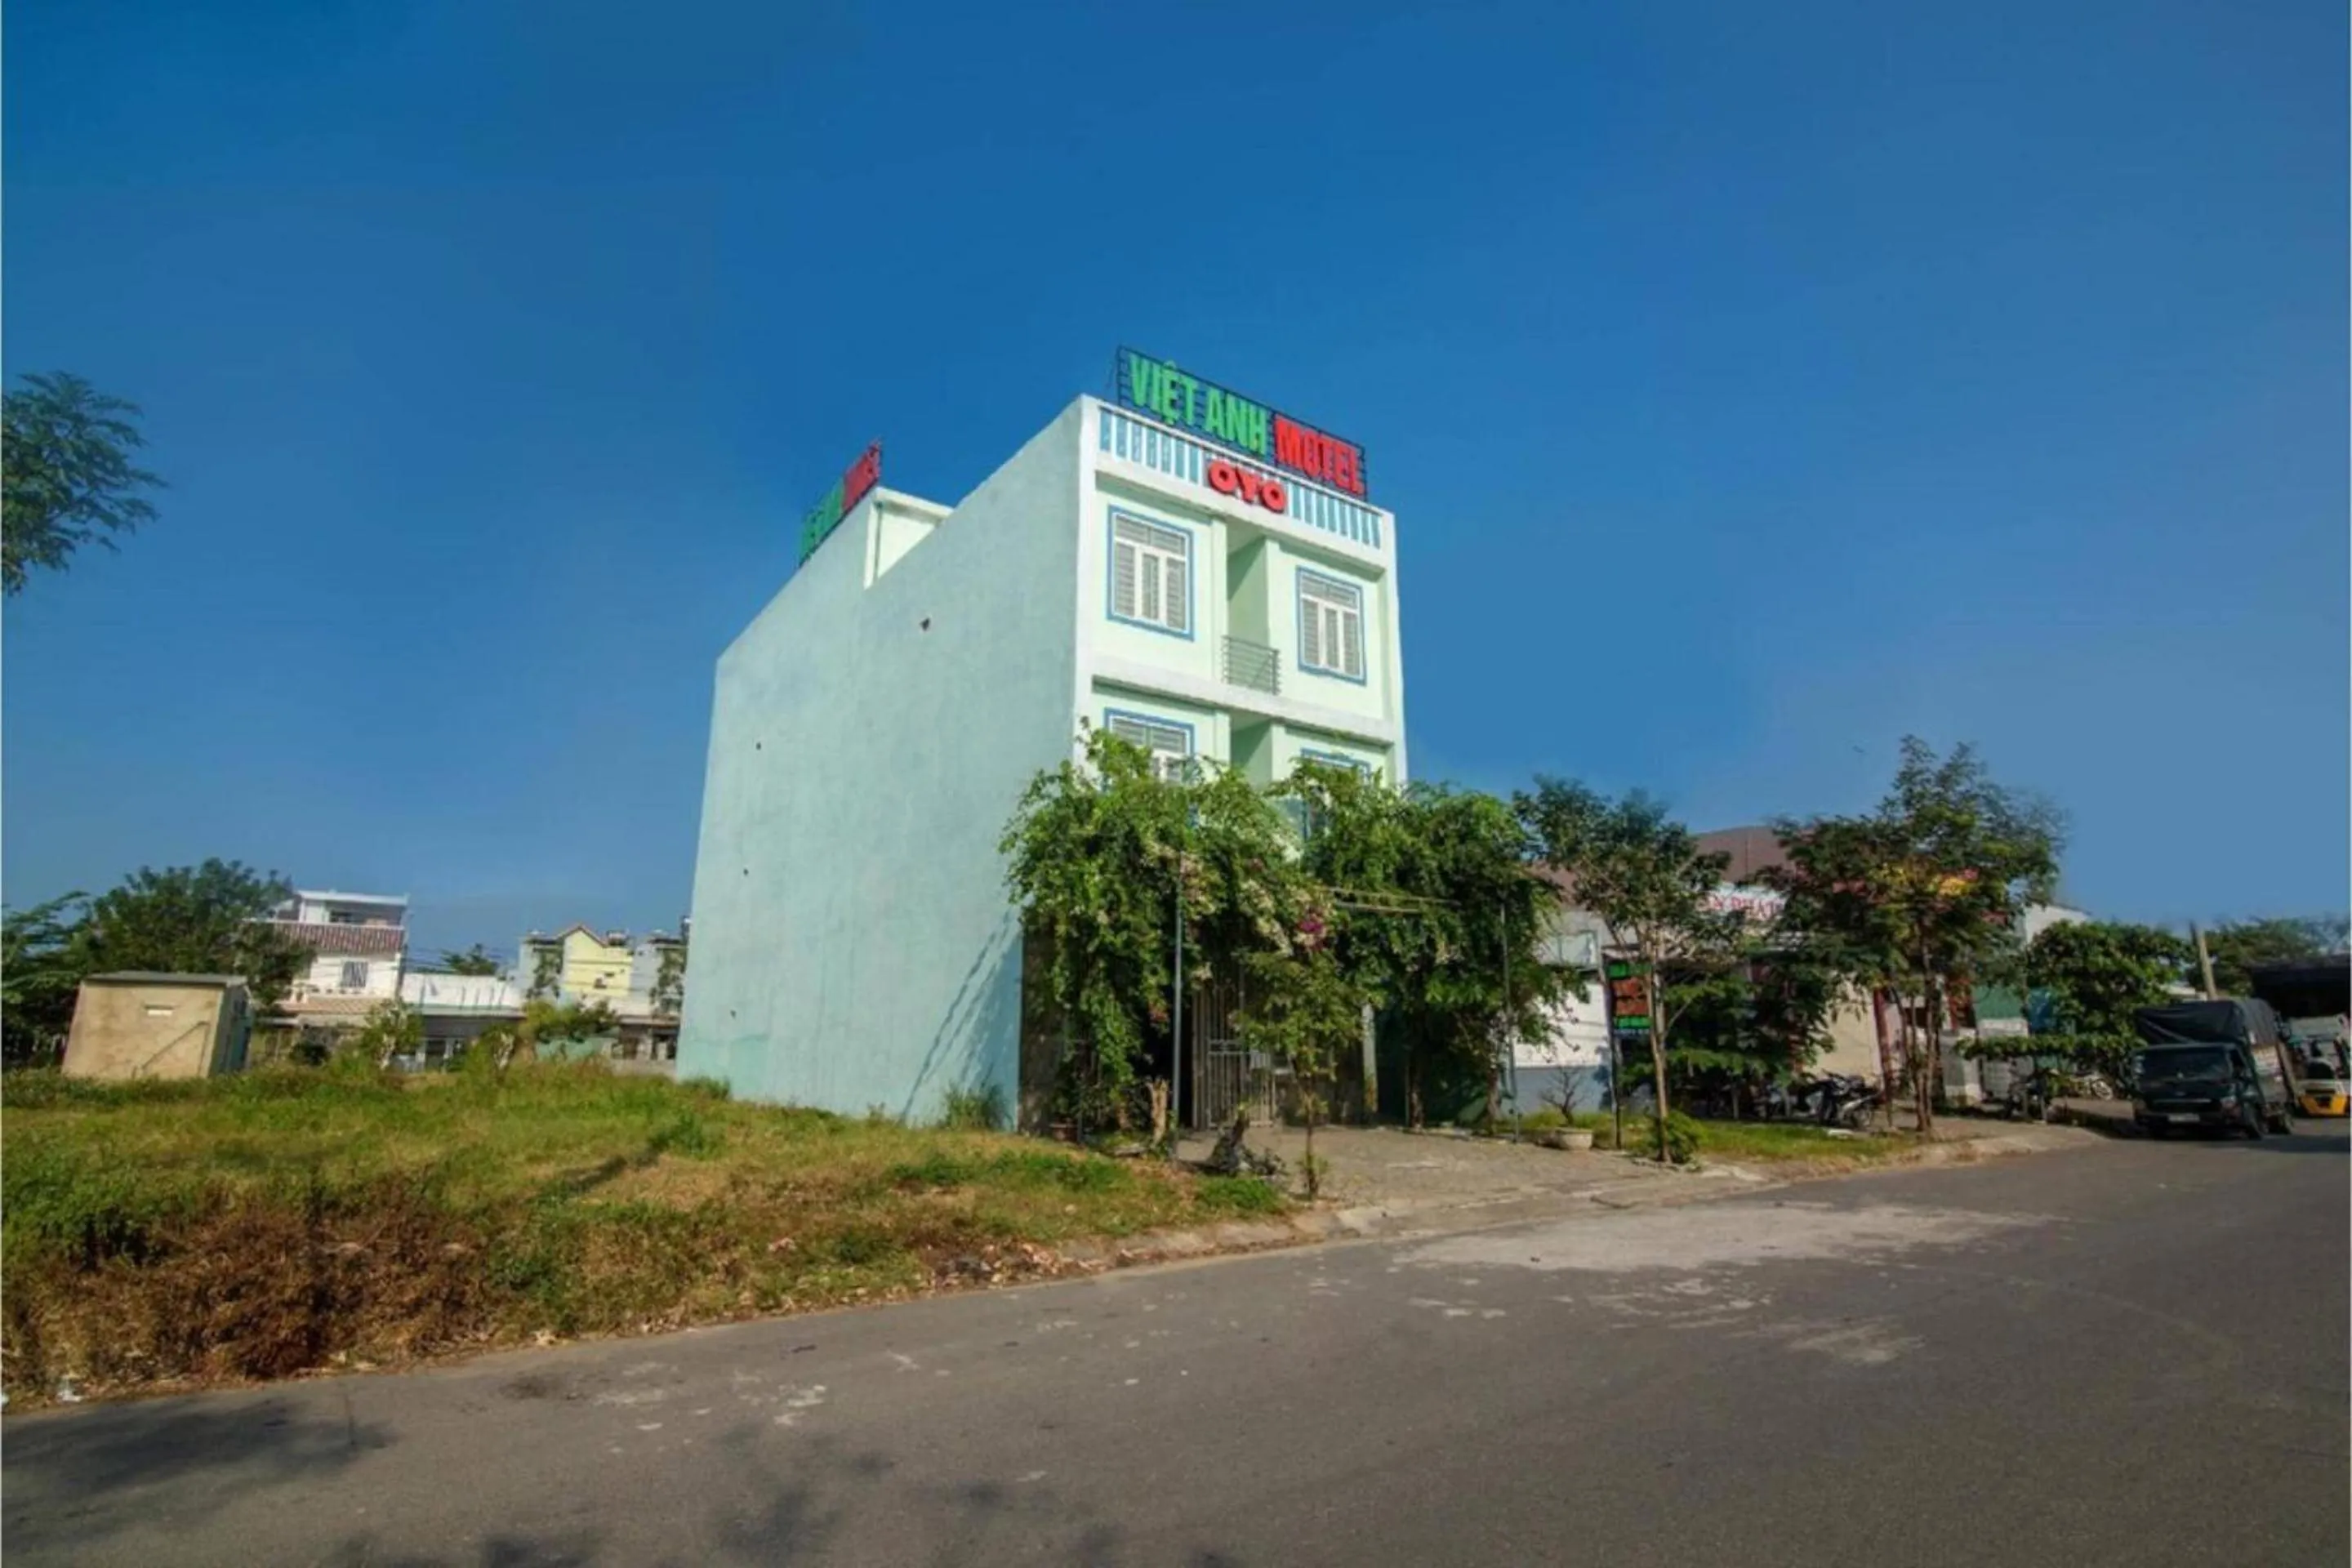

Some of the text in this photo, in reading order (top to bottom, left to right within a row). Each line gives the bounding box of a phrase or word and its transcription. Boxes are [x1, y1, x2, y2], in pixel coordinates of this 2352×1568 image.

[1129, 353, 1365, 495] VIỆT ANH MOTEL
[1208, 459, 1287, 513] OYO
